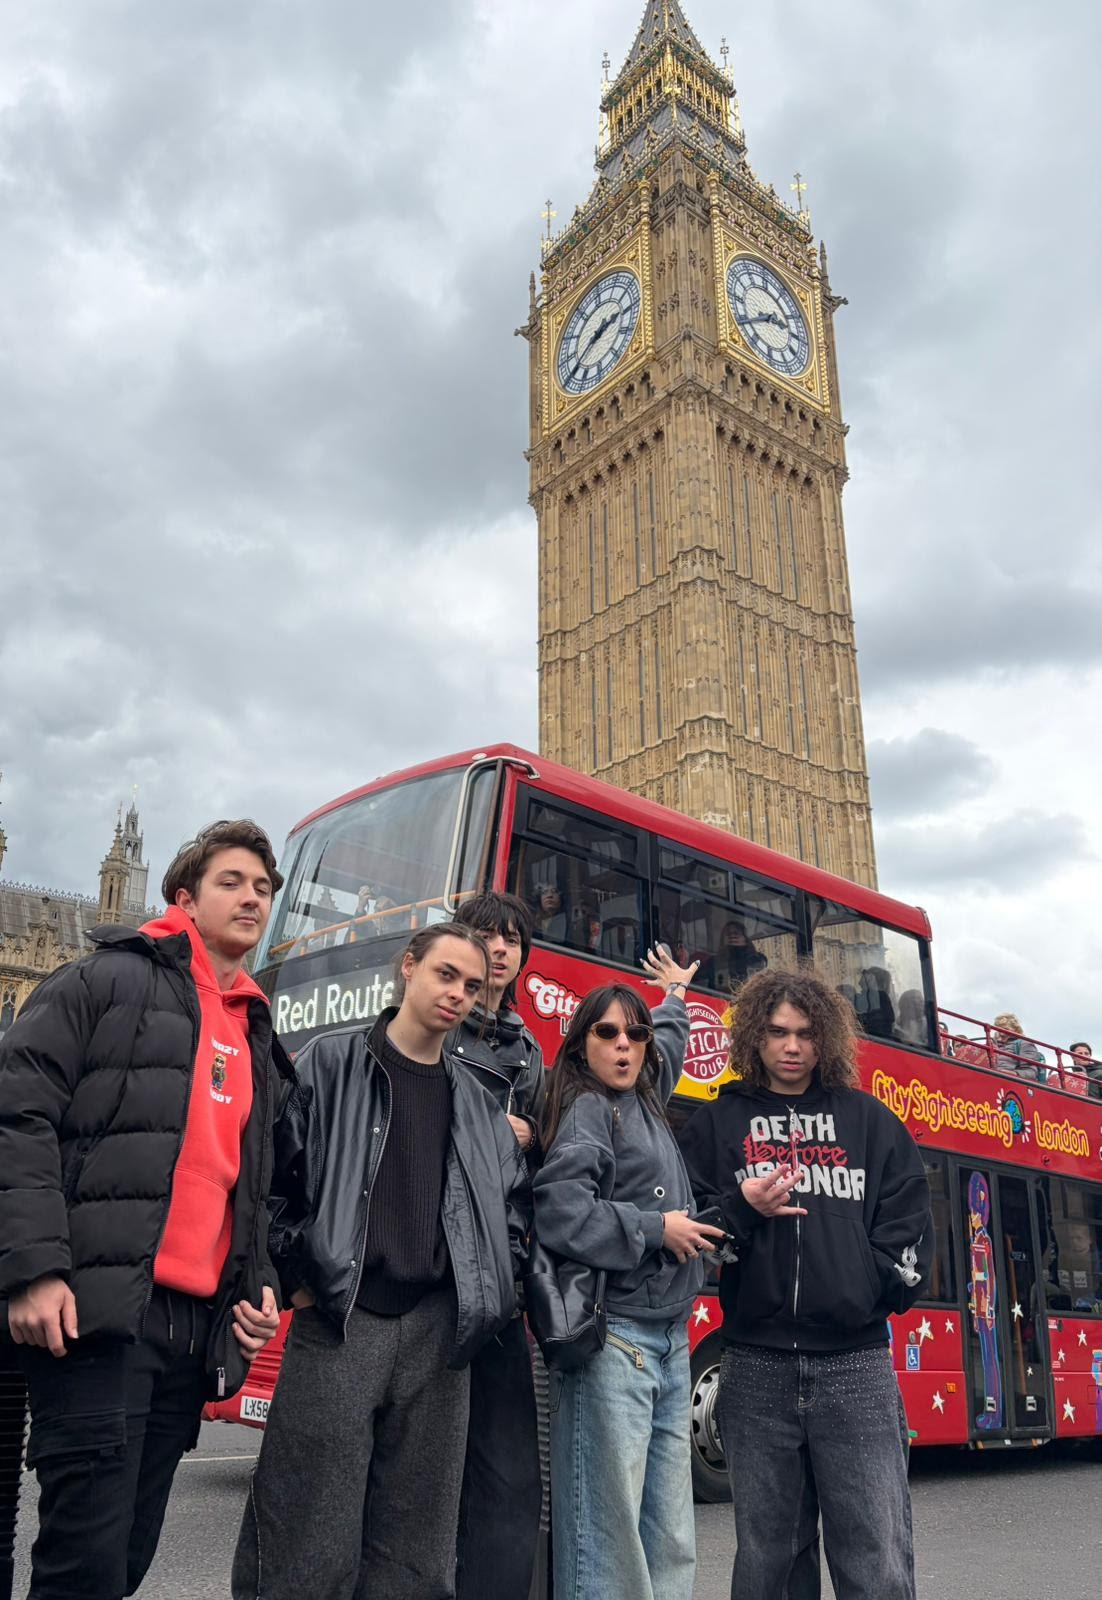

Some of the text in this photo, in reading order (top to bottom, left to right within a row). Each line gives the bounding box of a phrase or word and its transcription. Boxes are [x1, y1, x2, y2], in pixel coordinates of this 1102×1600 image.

[276, 974, 395, 1035] Red Route
[528, 977, 581, 1016] Cit
[685, 1007, 719, 1025] IGHTSEEING
[685, 1031, 733, 1058] FICIA
[693, 1056, 725, 1077] TOUR
[750, 1112, 836, 1142] DEATH
[1034, 1111, 1090, 1158] London
[743, 1131, 849, 1171] Before
[244, 1398, 269, 1418] LX58
